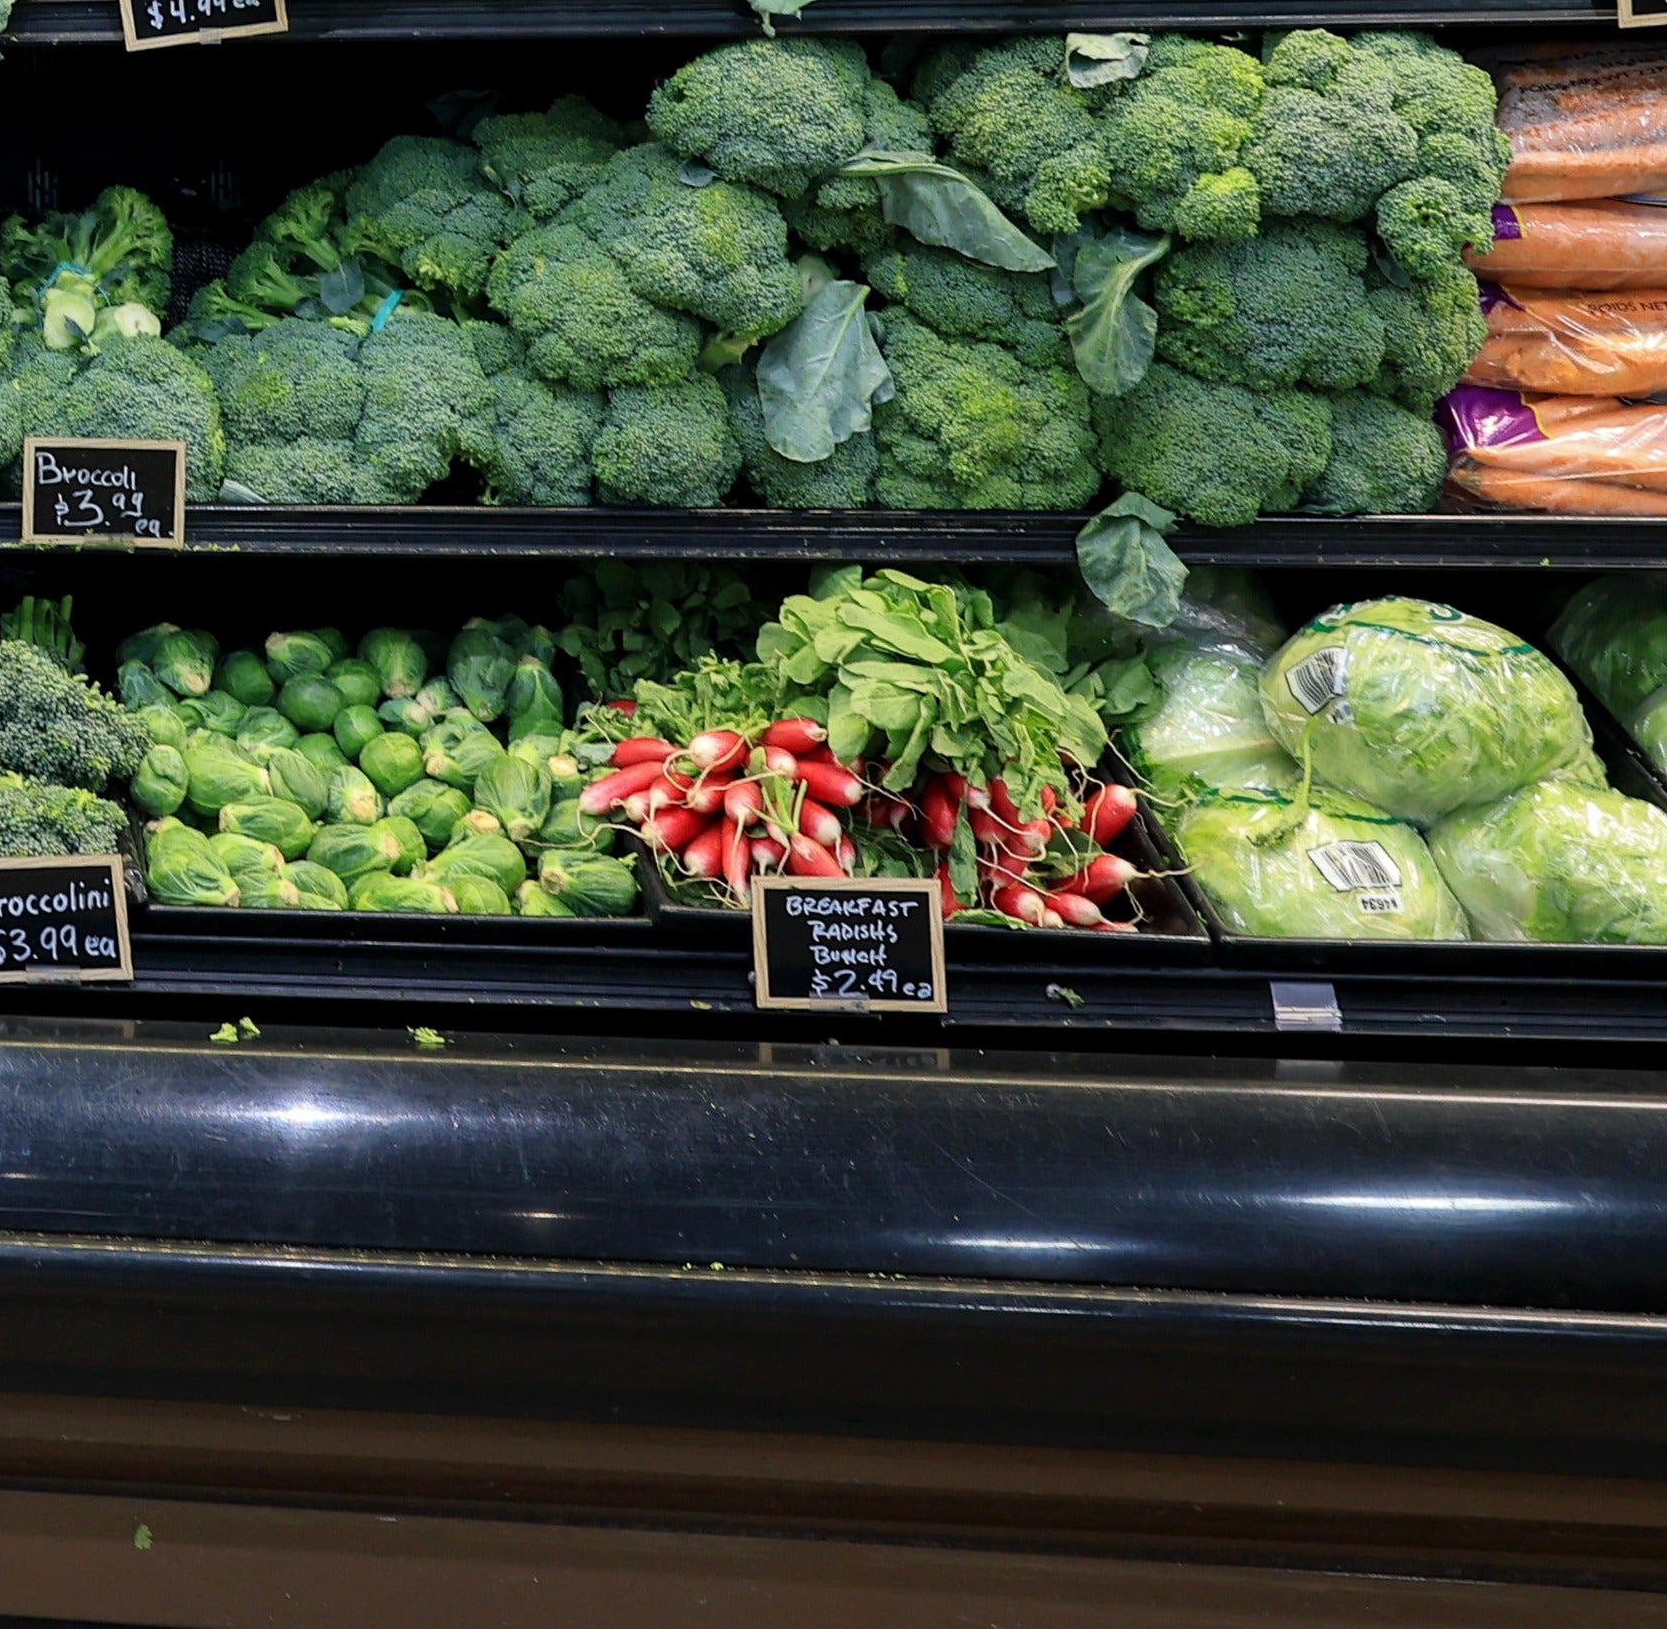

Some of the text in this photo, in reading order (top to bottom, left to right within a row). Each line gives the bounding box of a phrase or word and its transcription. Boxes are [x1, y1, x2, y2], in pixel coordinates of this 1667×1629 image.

[35, 451, 137, 491] Broccoli
[785, 895, 920, 918] BREAKFAST
[806, 919, 899, 944] RADISHS
[83, 934, 118, 959] ea
[808, 943, 888, 967] BUNCH
[811, 968, 933, 1000] $2.49 ea
